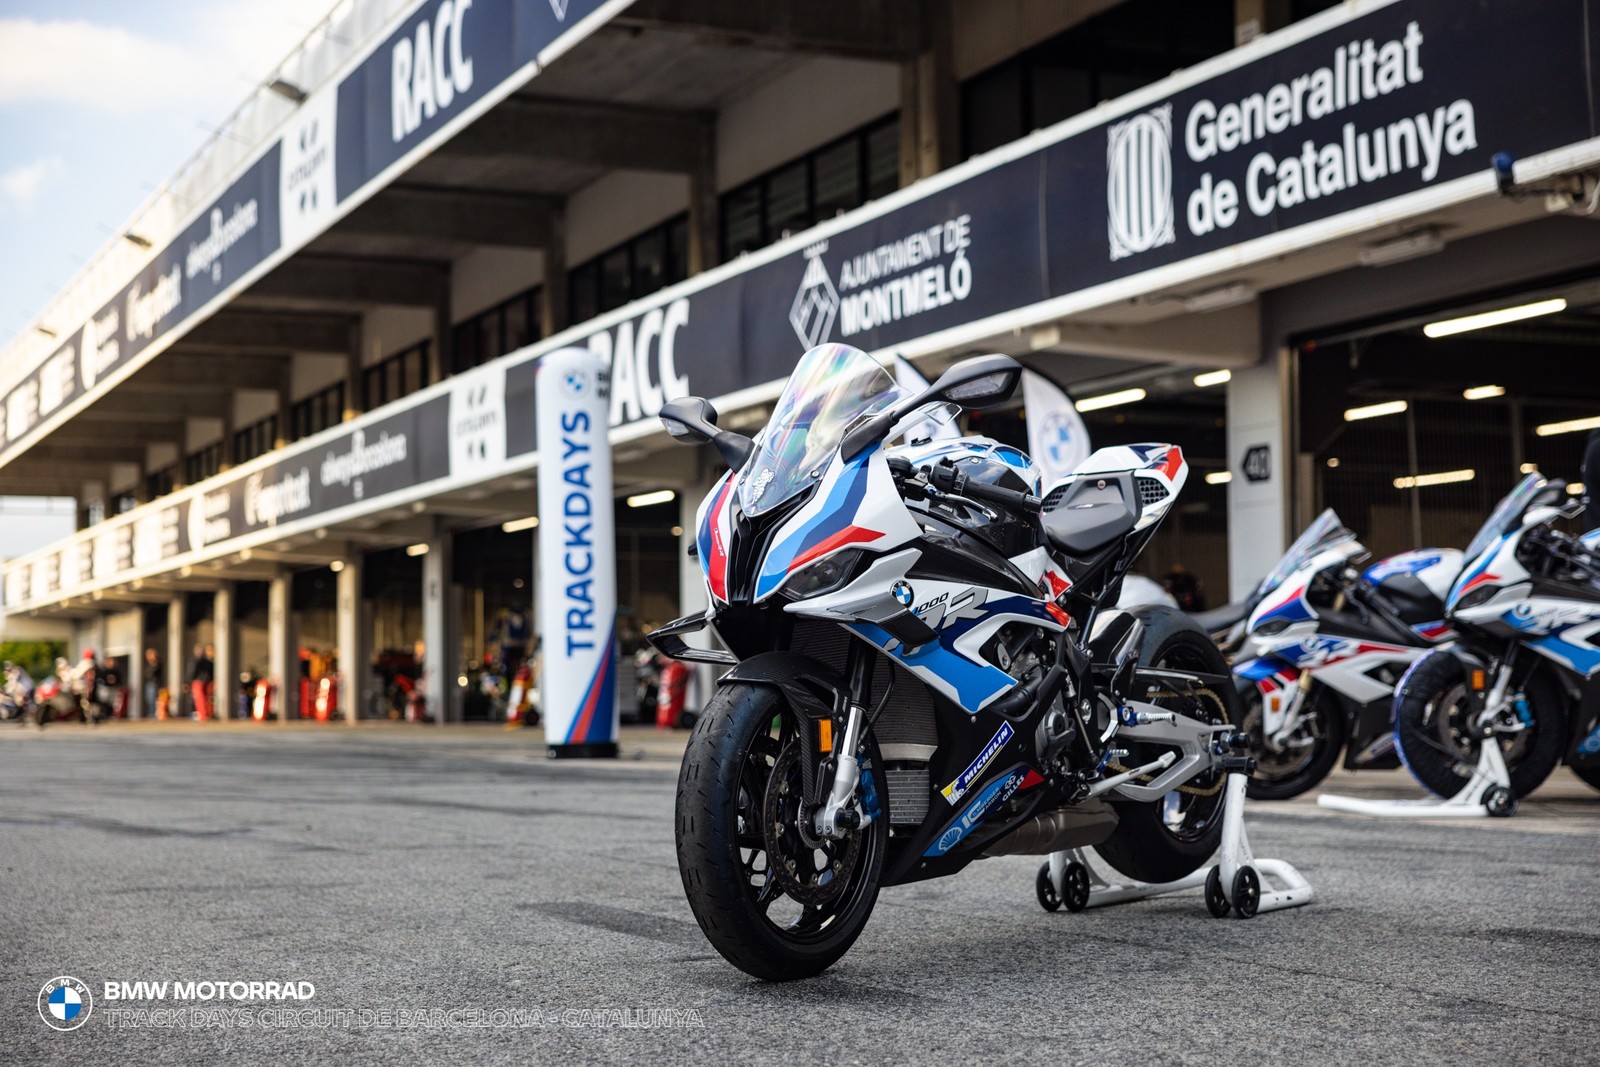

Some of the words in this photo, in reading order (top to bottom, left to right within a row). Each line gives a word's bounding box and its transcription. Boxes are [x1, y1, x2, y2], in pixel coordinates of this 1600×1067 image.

[391, 0, 473, 142] RACC
[1185, 20, 1424, 162] Generalitat
[1187, 172, 1239, 236] de
[1246, 99, 1478, 217] Catalunya
[839, 224, 943, 292] AJUNTAMENT
[943, 213, 971, 254] DE
[840, 248, 972, 337] MONTMELÓ
[561, 411, 596, 658] TRACKDAYS
[964, 727, 1009, 784] MICHELIN
[1002, 775, 1025, 801] GILLES
